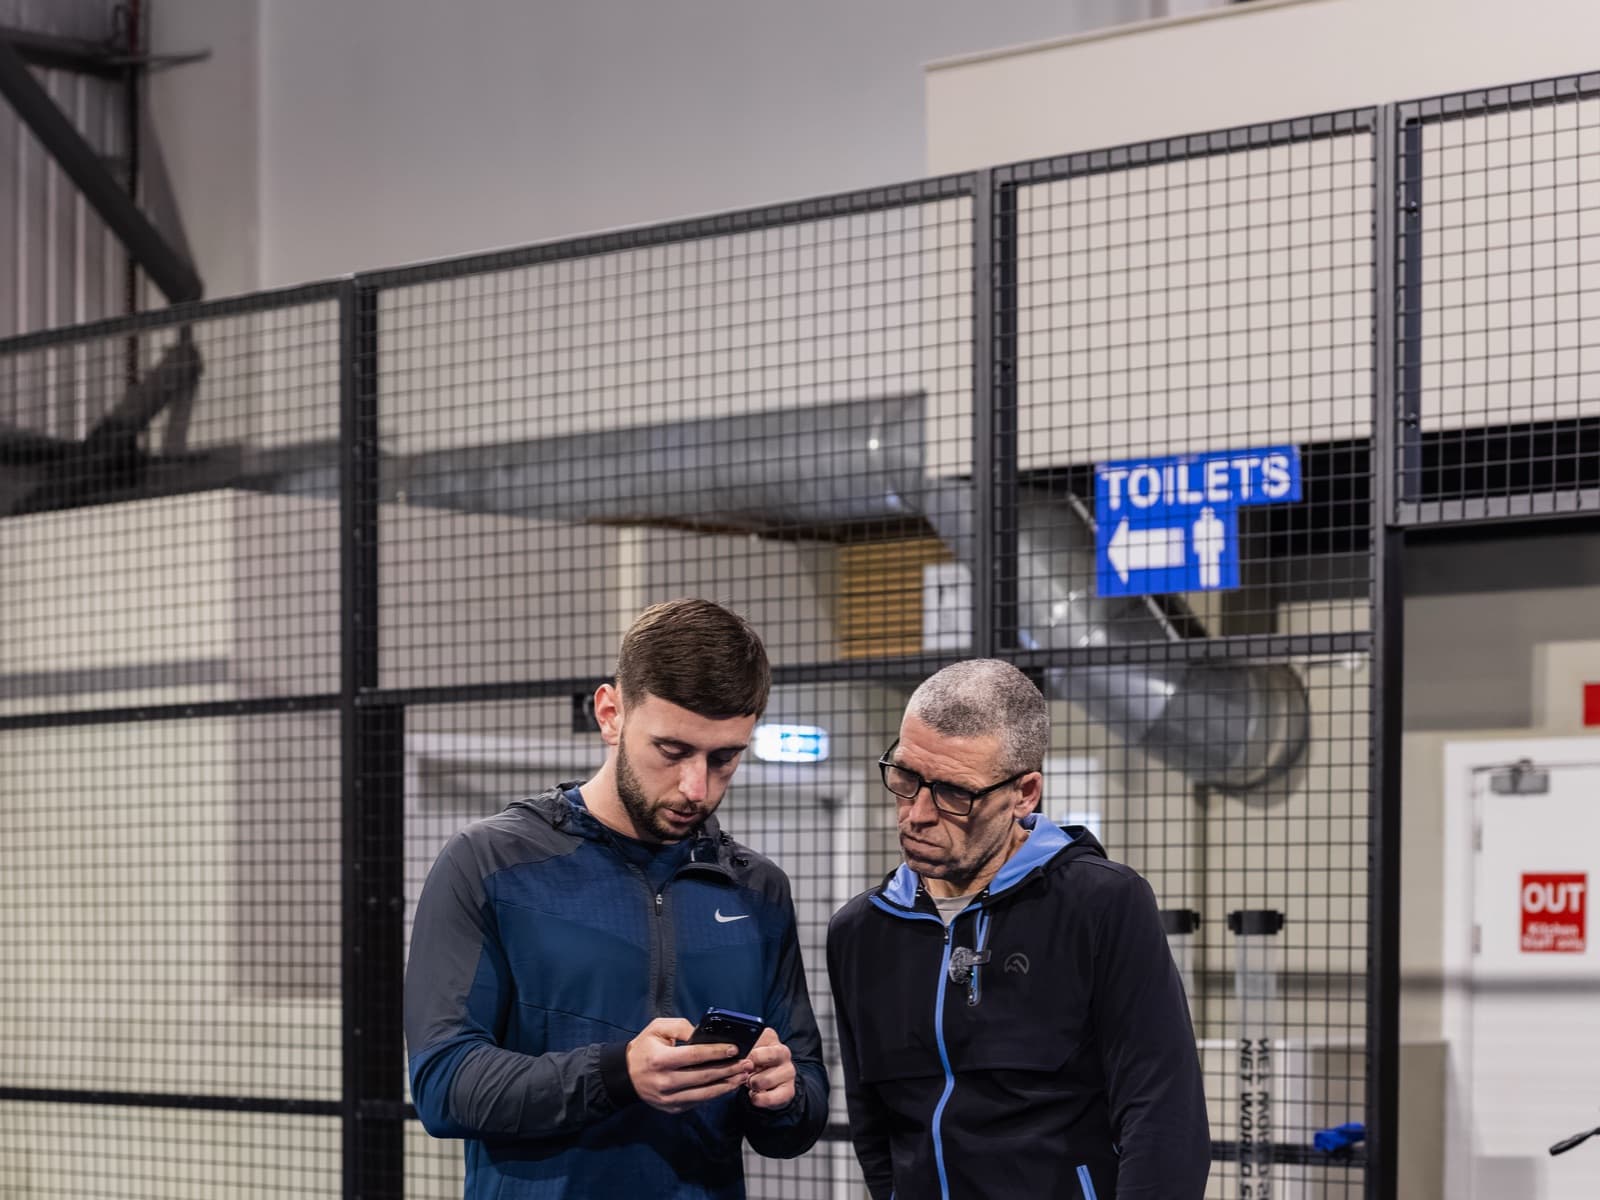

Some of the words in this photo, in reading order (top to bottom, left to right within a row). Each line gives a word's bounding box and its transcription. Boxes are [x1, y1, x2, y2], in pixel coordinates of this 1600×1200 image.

[1100, 453, 1291, 510] TOILETS
[1523, 882, 1585, 913] OUT
[1241, 1038, 1253, 1086] NET
